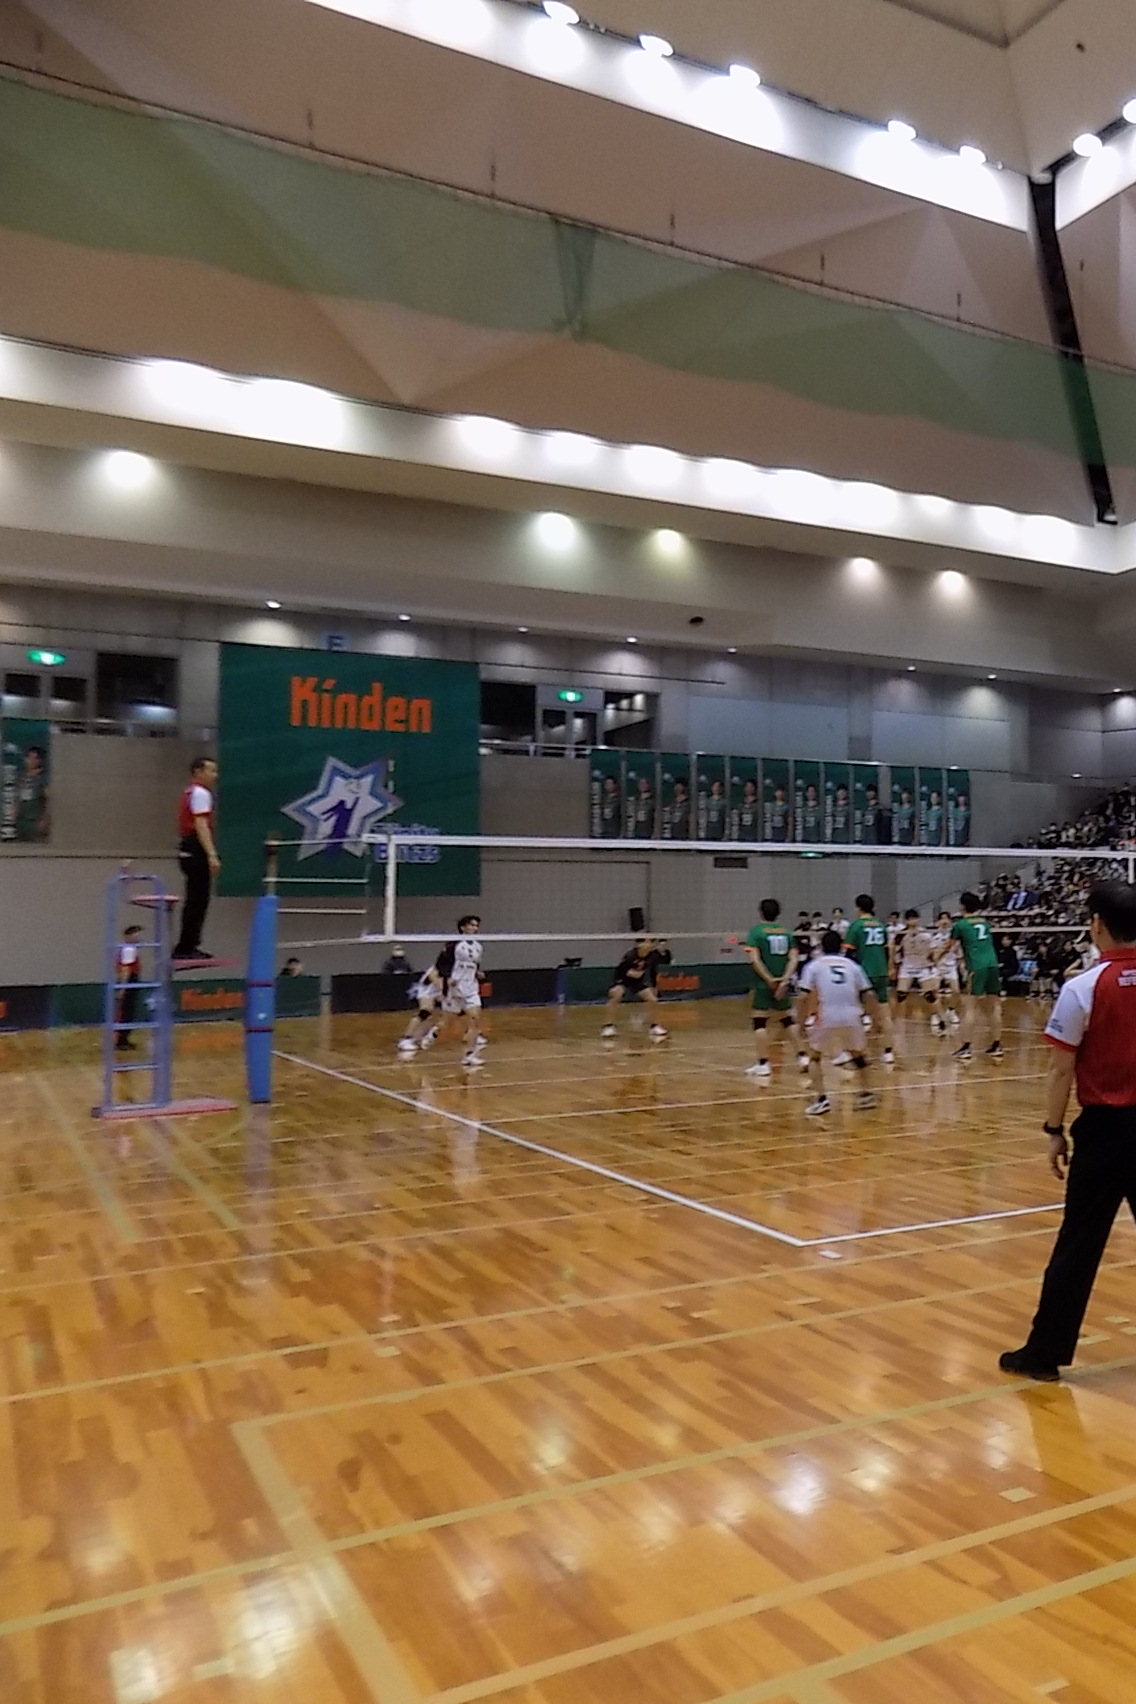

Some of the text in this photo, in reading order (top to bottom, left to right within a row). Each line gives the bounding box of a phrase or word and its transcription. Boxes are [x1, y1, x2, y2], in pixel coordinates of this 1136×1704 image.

[289, 676, 431, 733] Kinden
[974, 924, 988, 940] 2
[829, 965, 847, 984] 5
